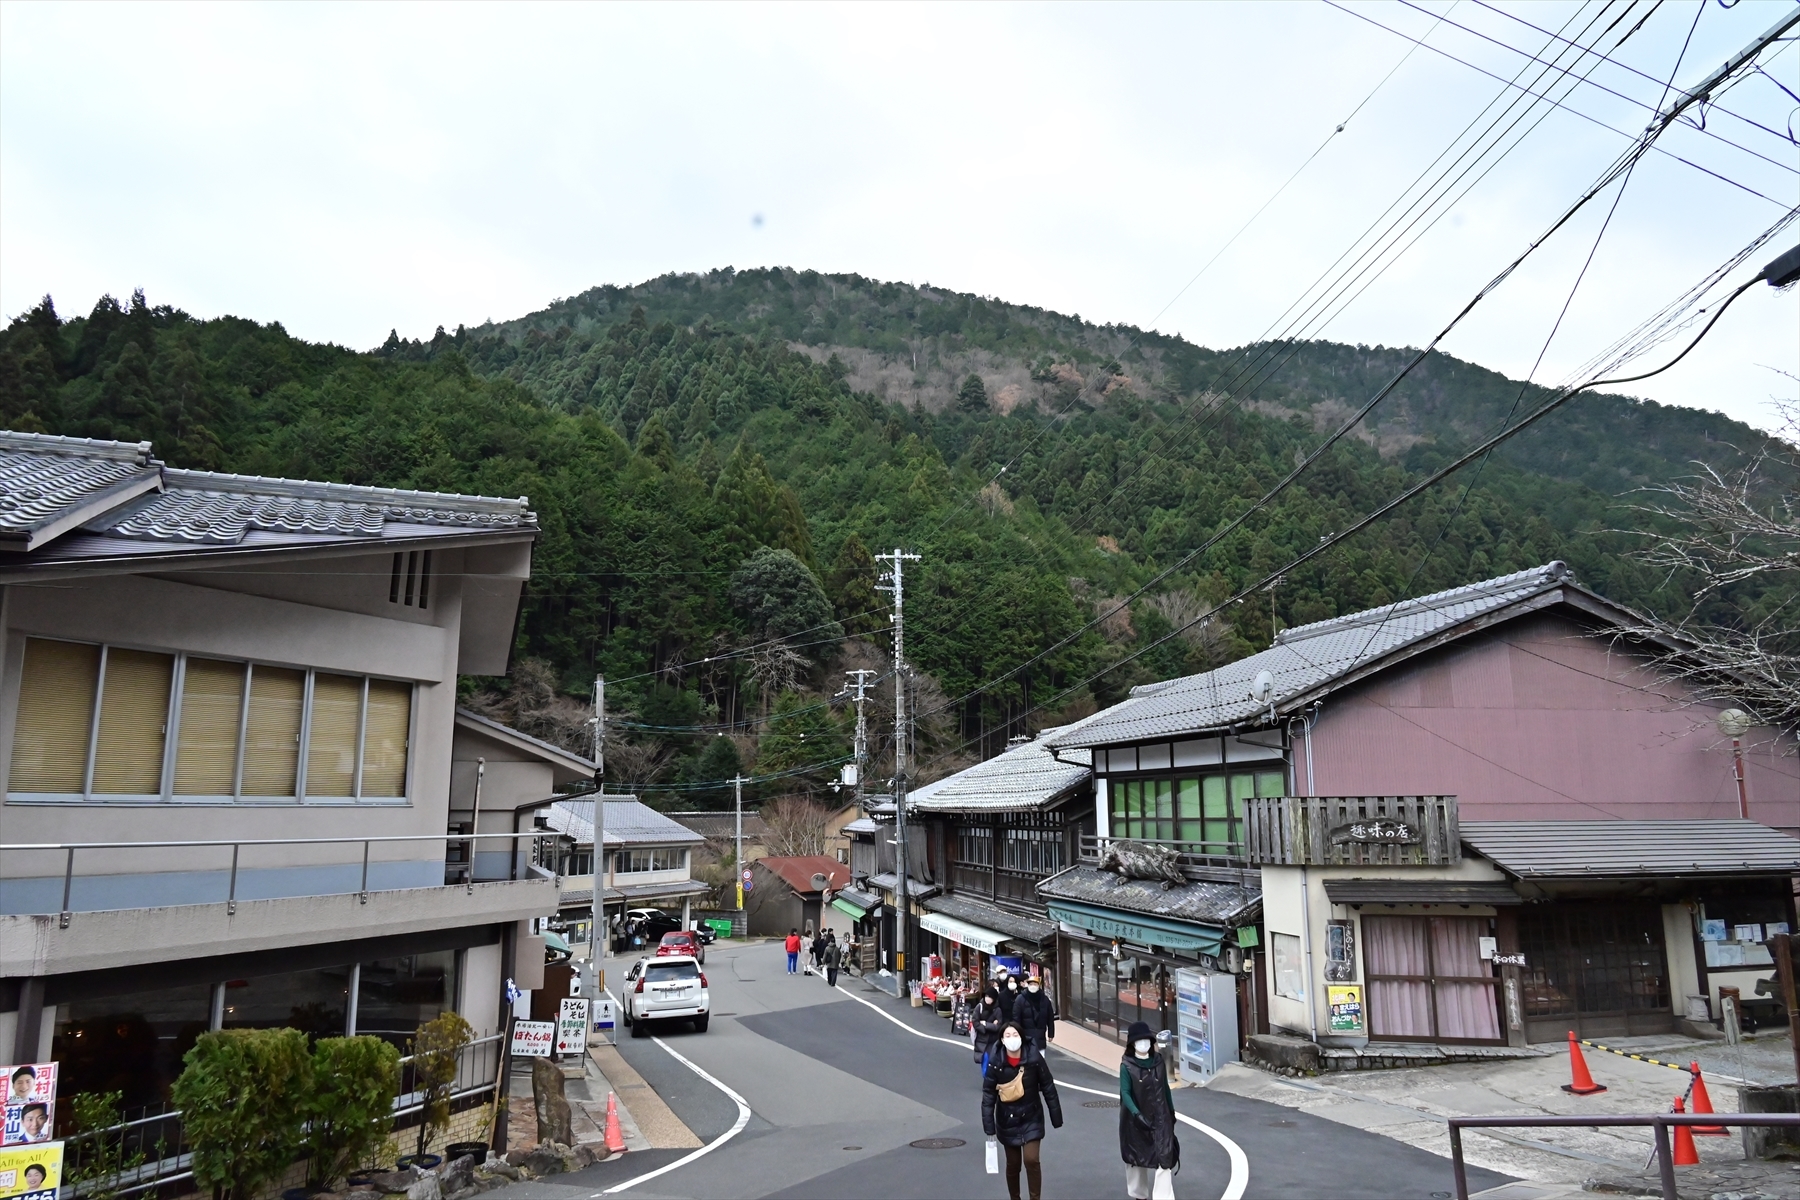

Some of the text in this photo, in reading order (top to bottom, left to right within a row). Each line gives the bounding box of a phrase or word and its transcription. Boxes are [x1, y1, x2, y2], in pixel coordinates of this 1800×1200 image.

[1350, 822, 1409, 839] 趣味の店
[1492, 954, 1526, 965] 本日休業
[563, 1001, 585, 1011] うどん
[569, 1011, 586, 1020] そば
[560, 1019, 586, 1029] 季節料理
[514, 1030, 552, 1042] ぼたん鍋
[562, 1029, 582, 1038] 喫茶
[35, 1067, 52, 1094] 河村
[6, 1107, 21, 1134] 村山
